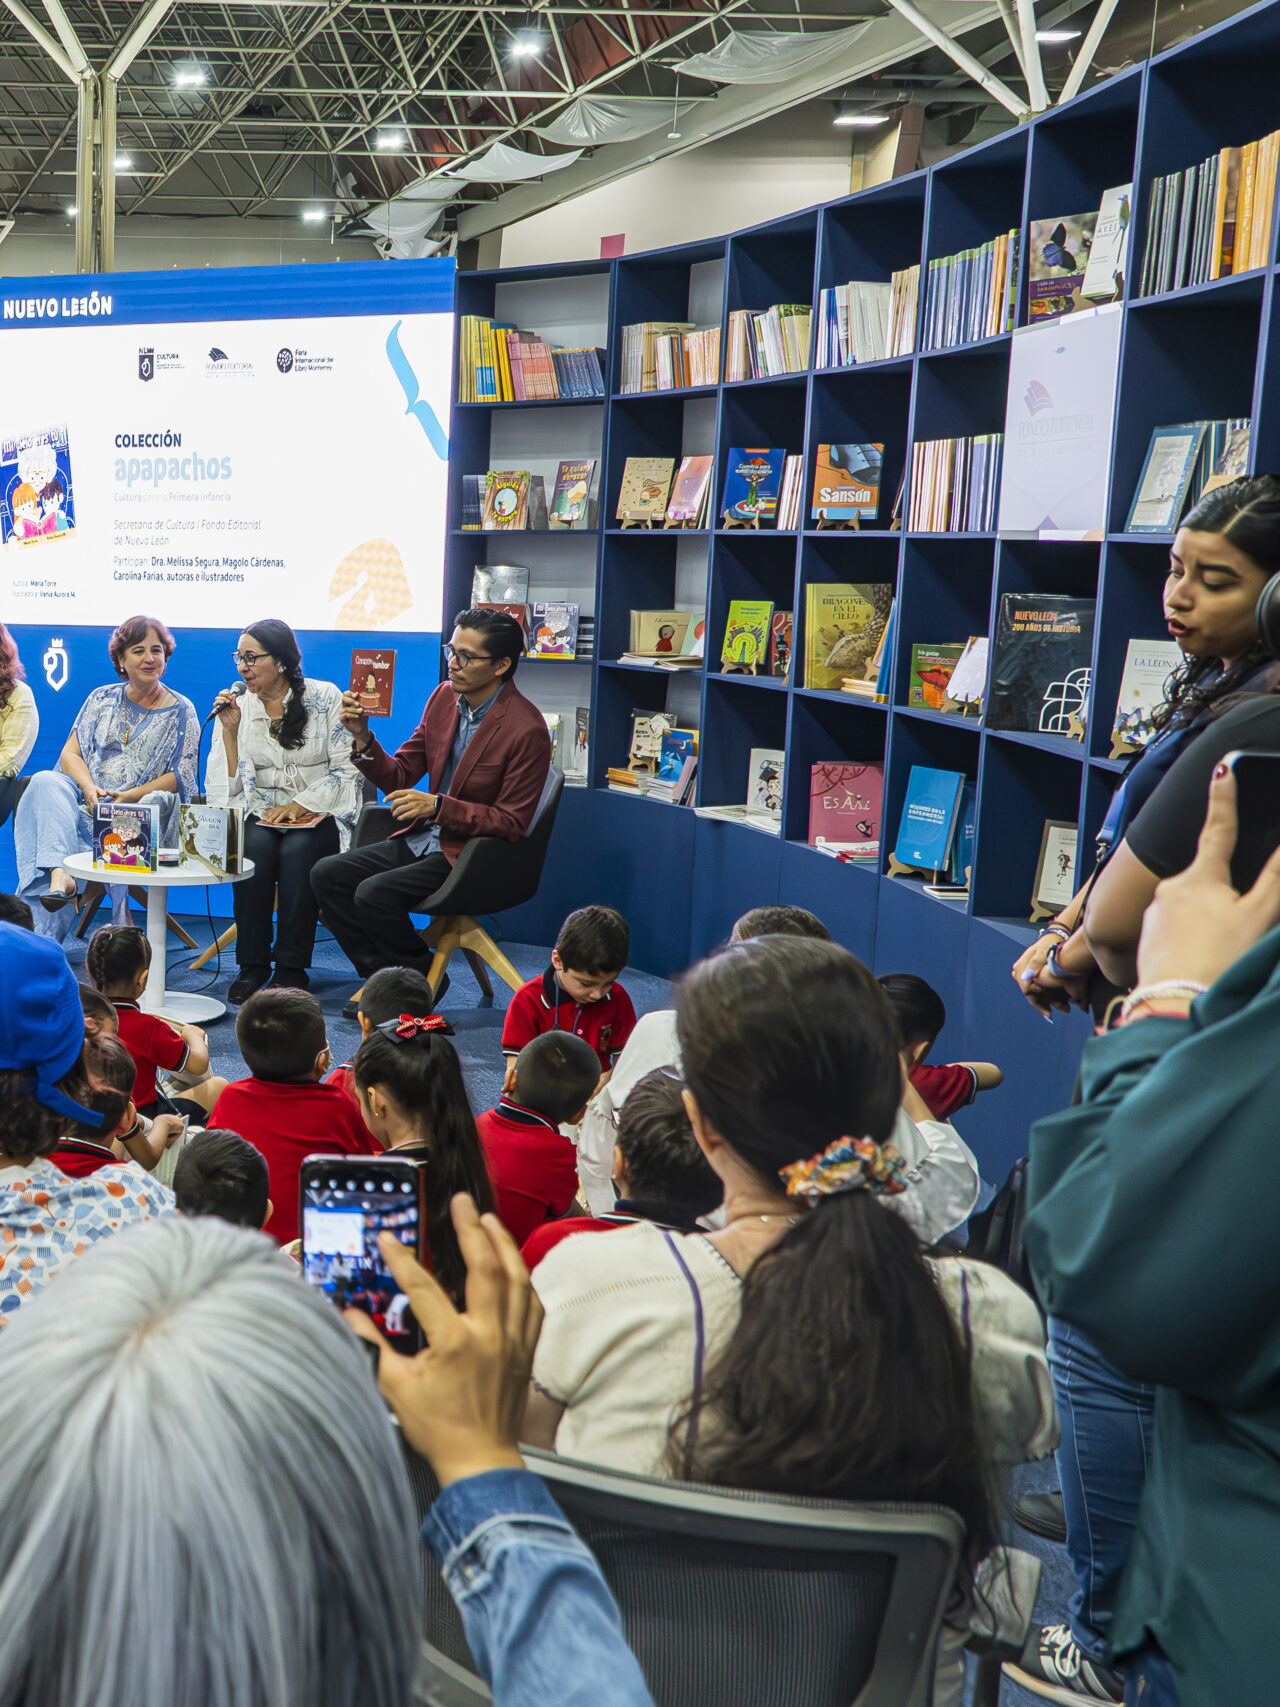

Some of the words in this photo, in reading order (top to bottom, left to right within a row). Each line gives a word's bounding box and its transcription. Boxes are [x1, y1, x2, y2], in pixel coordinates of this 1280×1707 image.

[3, 298, 59, 319] NUEVO
[114, 429, 182, 448] COLECCIÓN
[114, 451, 233, 488] apapachos
[819, 487, 871, 503] Sansón
[154, 519, 164, 530] de
[166, 519, 195, 530] Cultura
[201, 519, 226, 530] Fondo
[227, 519, 262, 530] Editorial
[114, 535, 123, 546] de
[125, 535, 149, 546] Nuevo
[151, 555, 166, 567] Dra.
[166, 555, 193, 567] Melissa
[222, 556, 249, 570] Magolo
[250, 556, 286, 569] Cárdenas,
[113, 570, 142, 582] Carolina
[166, 571, 194, 582] autoras
[201, 571, 245, 582] ilustradores
[1014, 610, 1038, 621] NUEVO
[1012, 623, 1025, 632] 200
[1025, 623, 1041, 633] AÑOS
[1042, 624, 1052, 633] DE
[1052, 625, 1081, 634] HISTORIA
